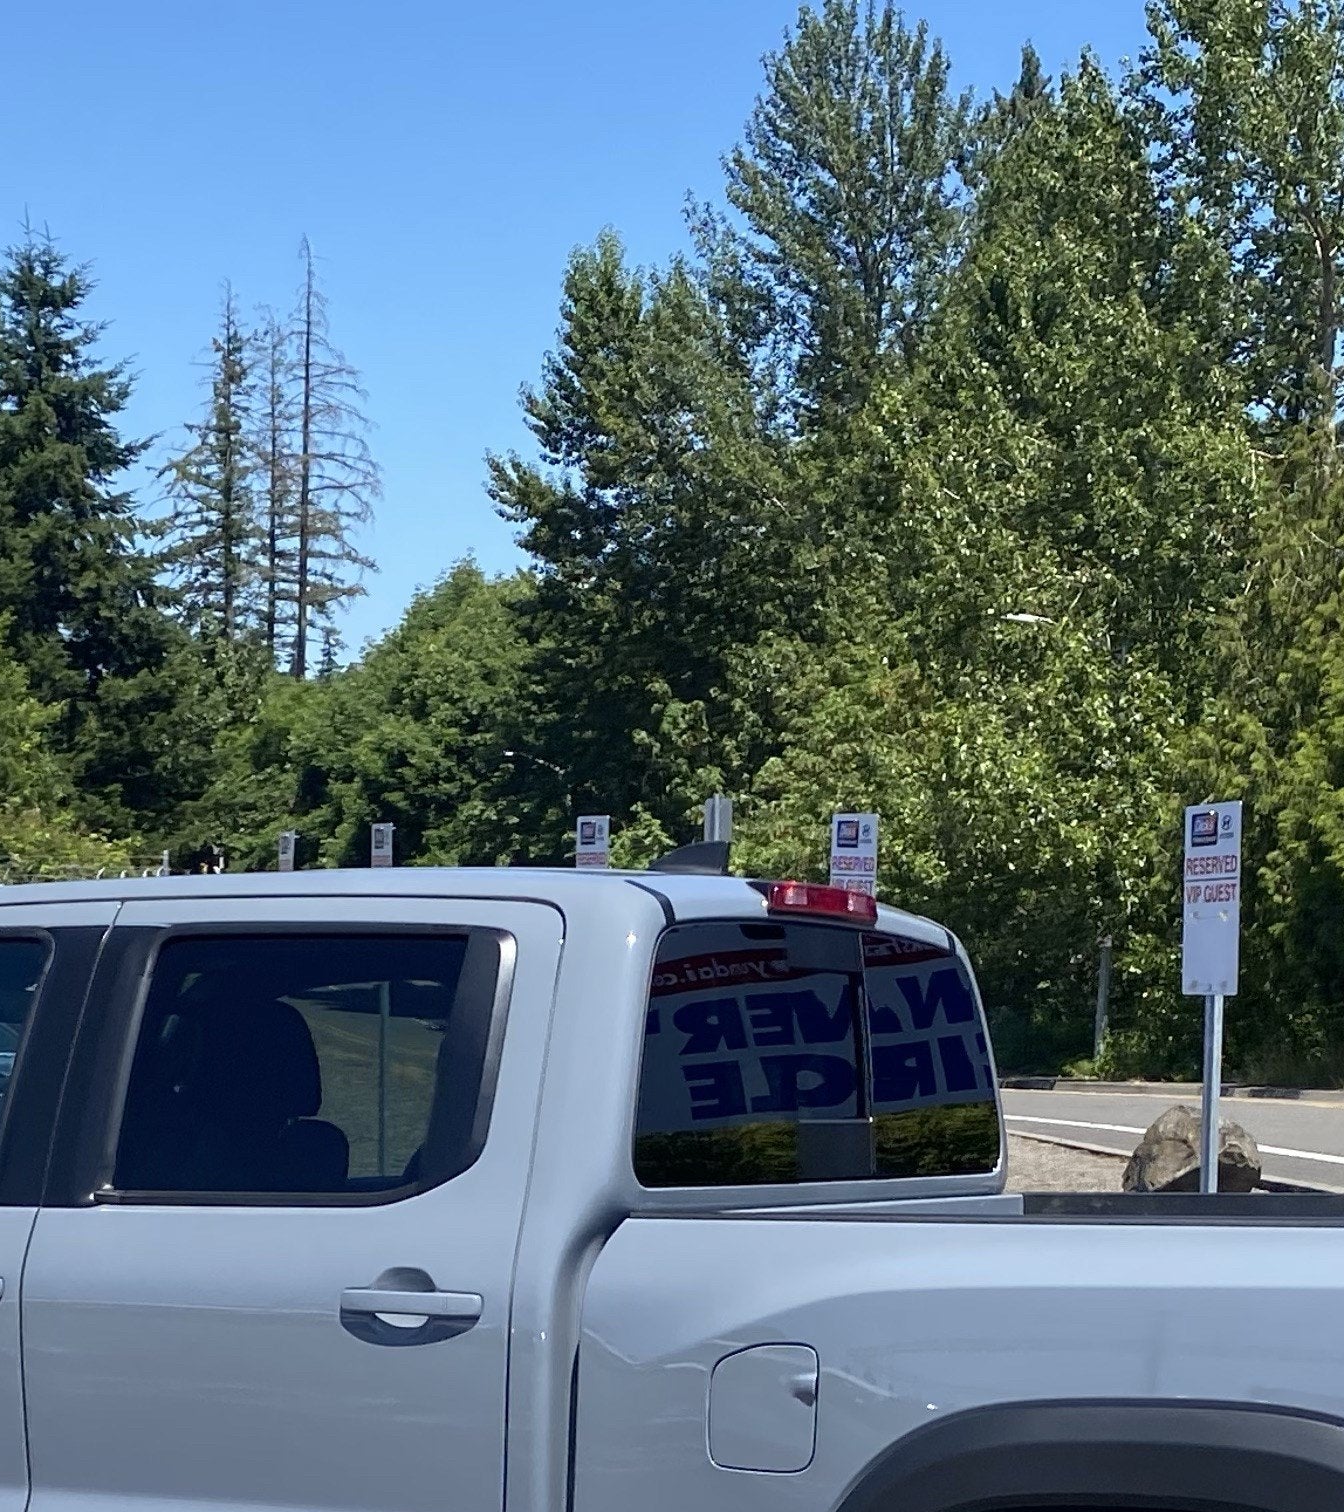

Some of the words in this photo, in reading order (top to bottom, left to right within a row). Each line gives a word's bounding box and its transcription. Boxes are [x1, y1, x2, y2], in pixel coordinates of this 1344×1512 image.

[1185, 854, 1238, 877] RESERVED
[1186, 884, 1202, 904] VIP
[1203, 883, 1237, 904] GUEST
